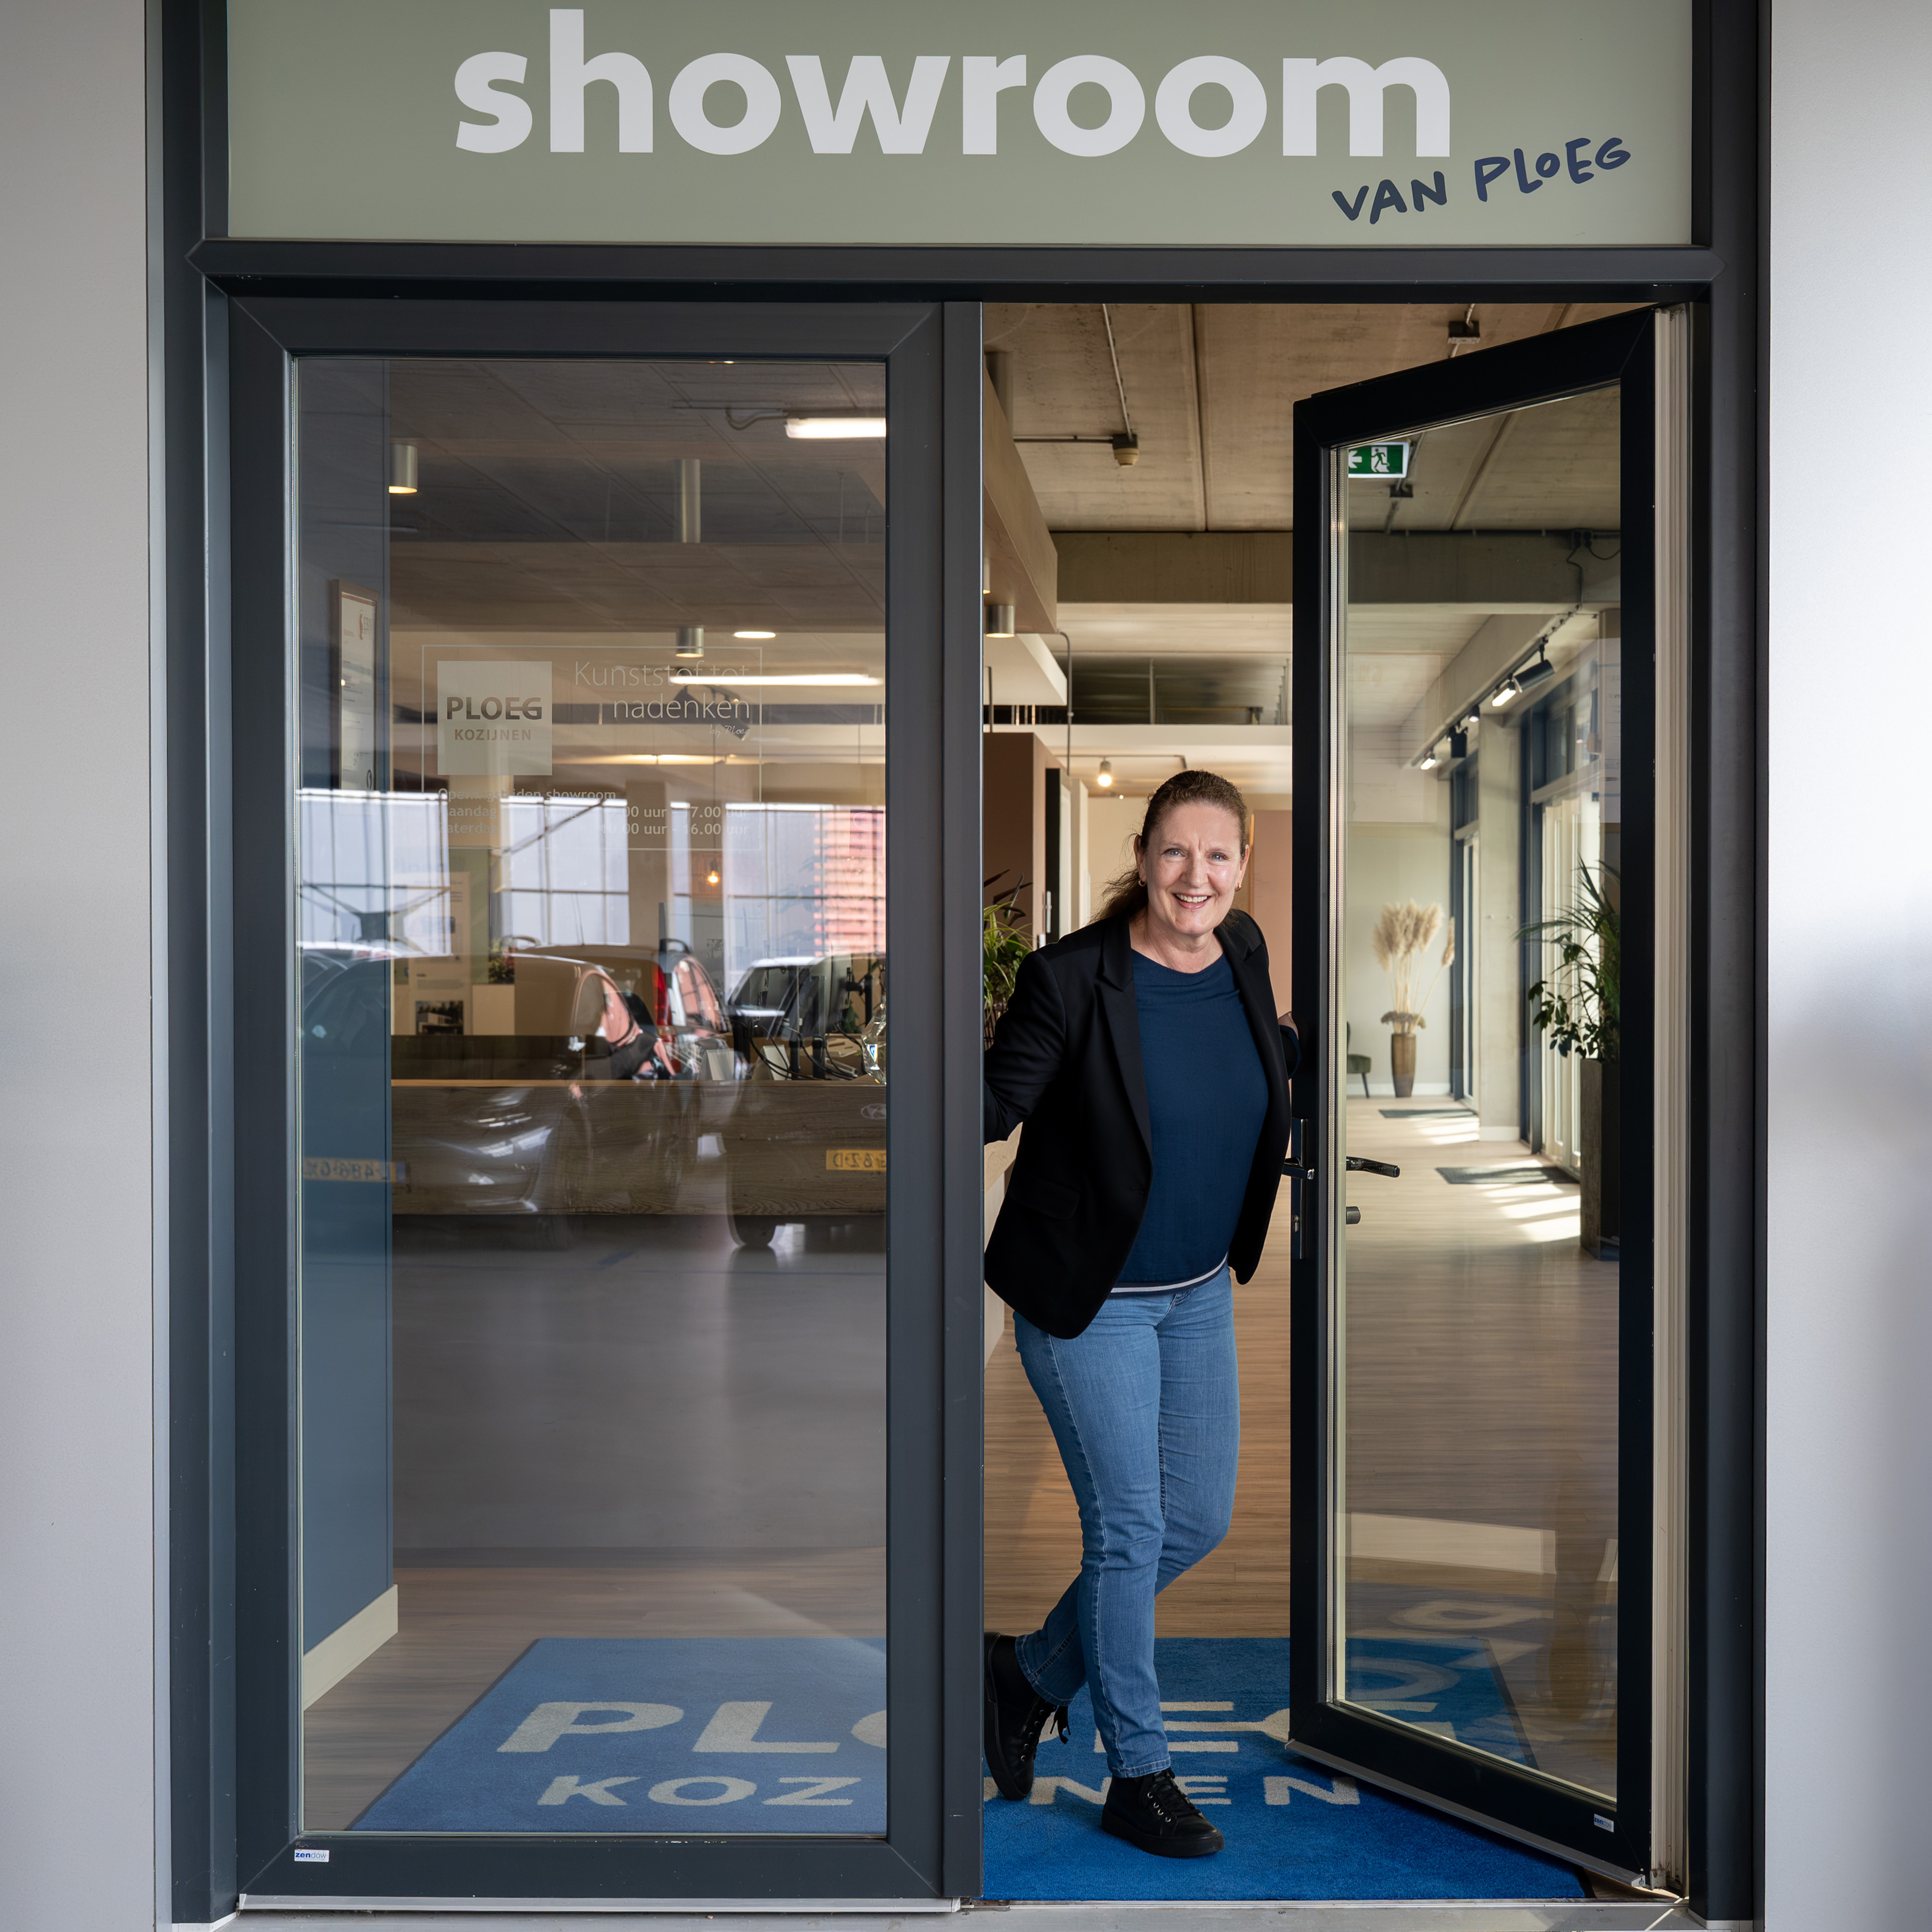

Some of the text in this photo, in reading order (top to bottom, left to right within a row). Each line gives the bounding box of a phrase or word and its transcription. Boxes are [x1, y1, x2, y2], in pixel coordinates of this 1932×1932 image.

[455, 9, 1450, 157] showroom
[1332, 138, 1631, 224] VAN PLOEG
[576, 660, 705, 686] Kunststof
[447, 697, 542, 720] PLOEG
[614, 693, 750, 718] nadenken
[454, 729, 531, 741] KOZIJNEN
[546, 789, 616, 800] showroom
[439, 805, 496, 819] aandag
[644, 808, 667, 817] uur
[440, 822, 498, 836] aterdag
[644, 825, 667, 834] uur
[727, 826, 749, 834] uur
